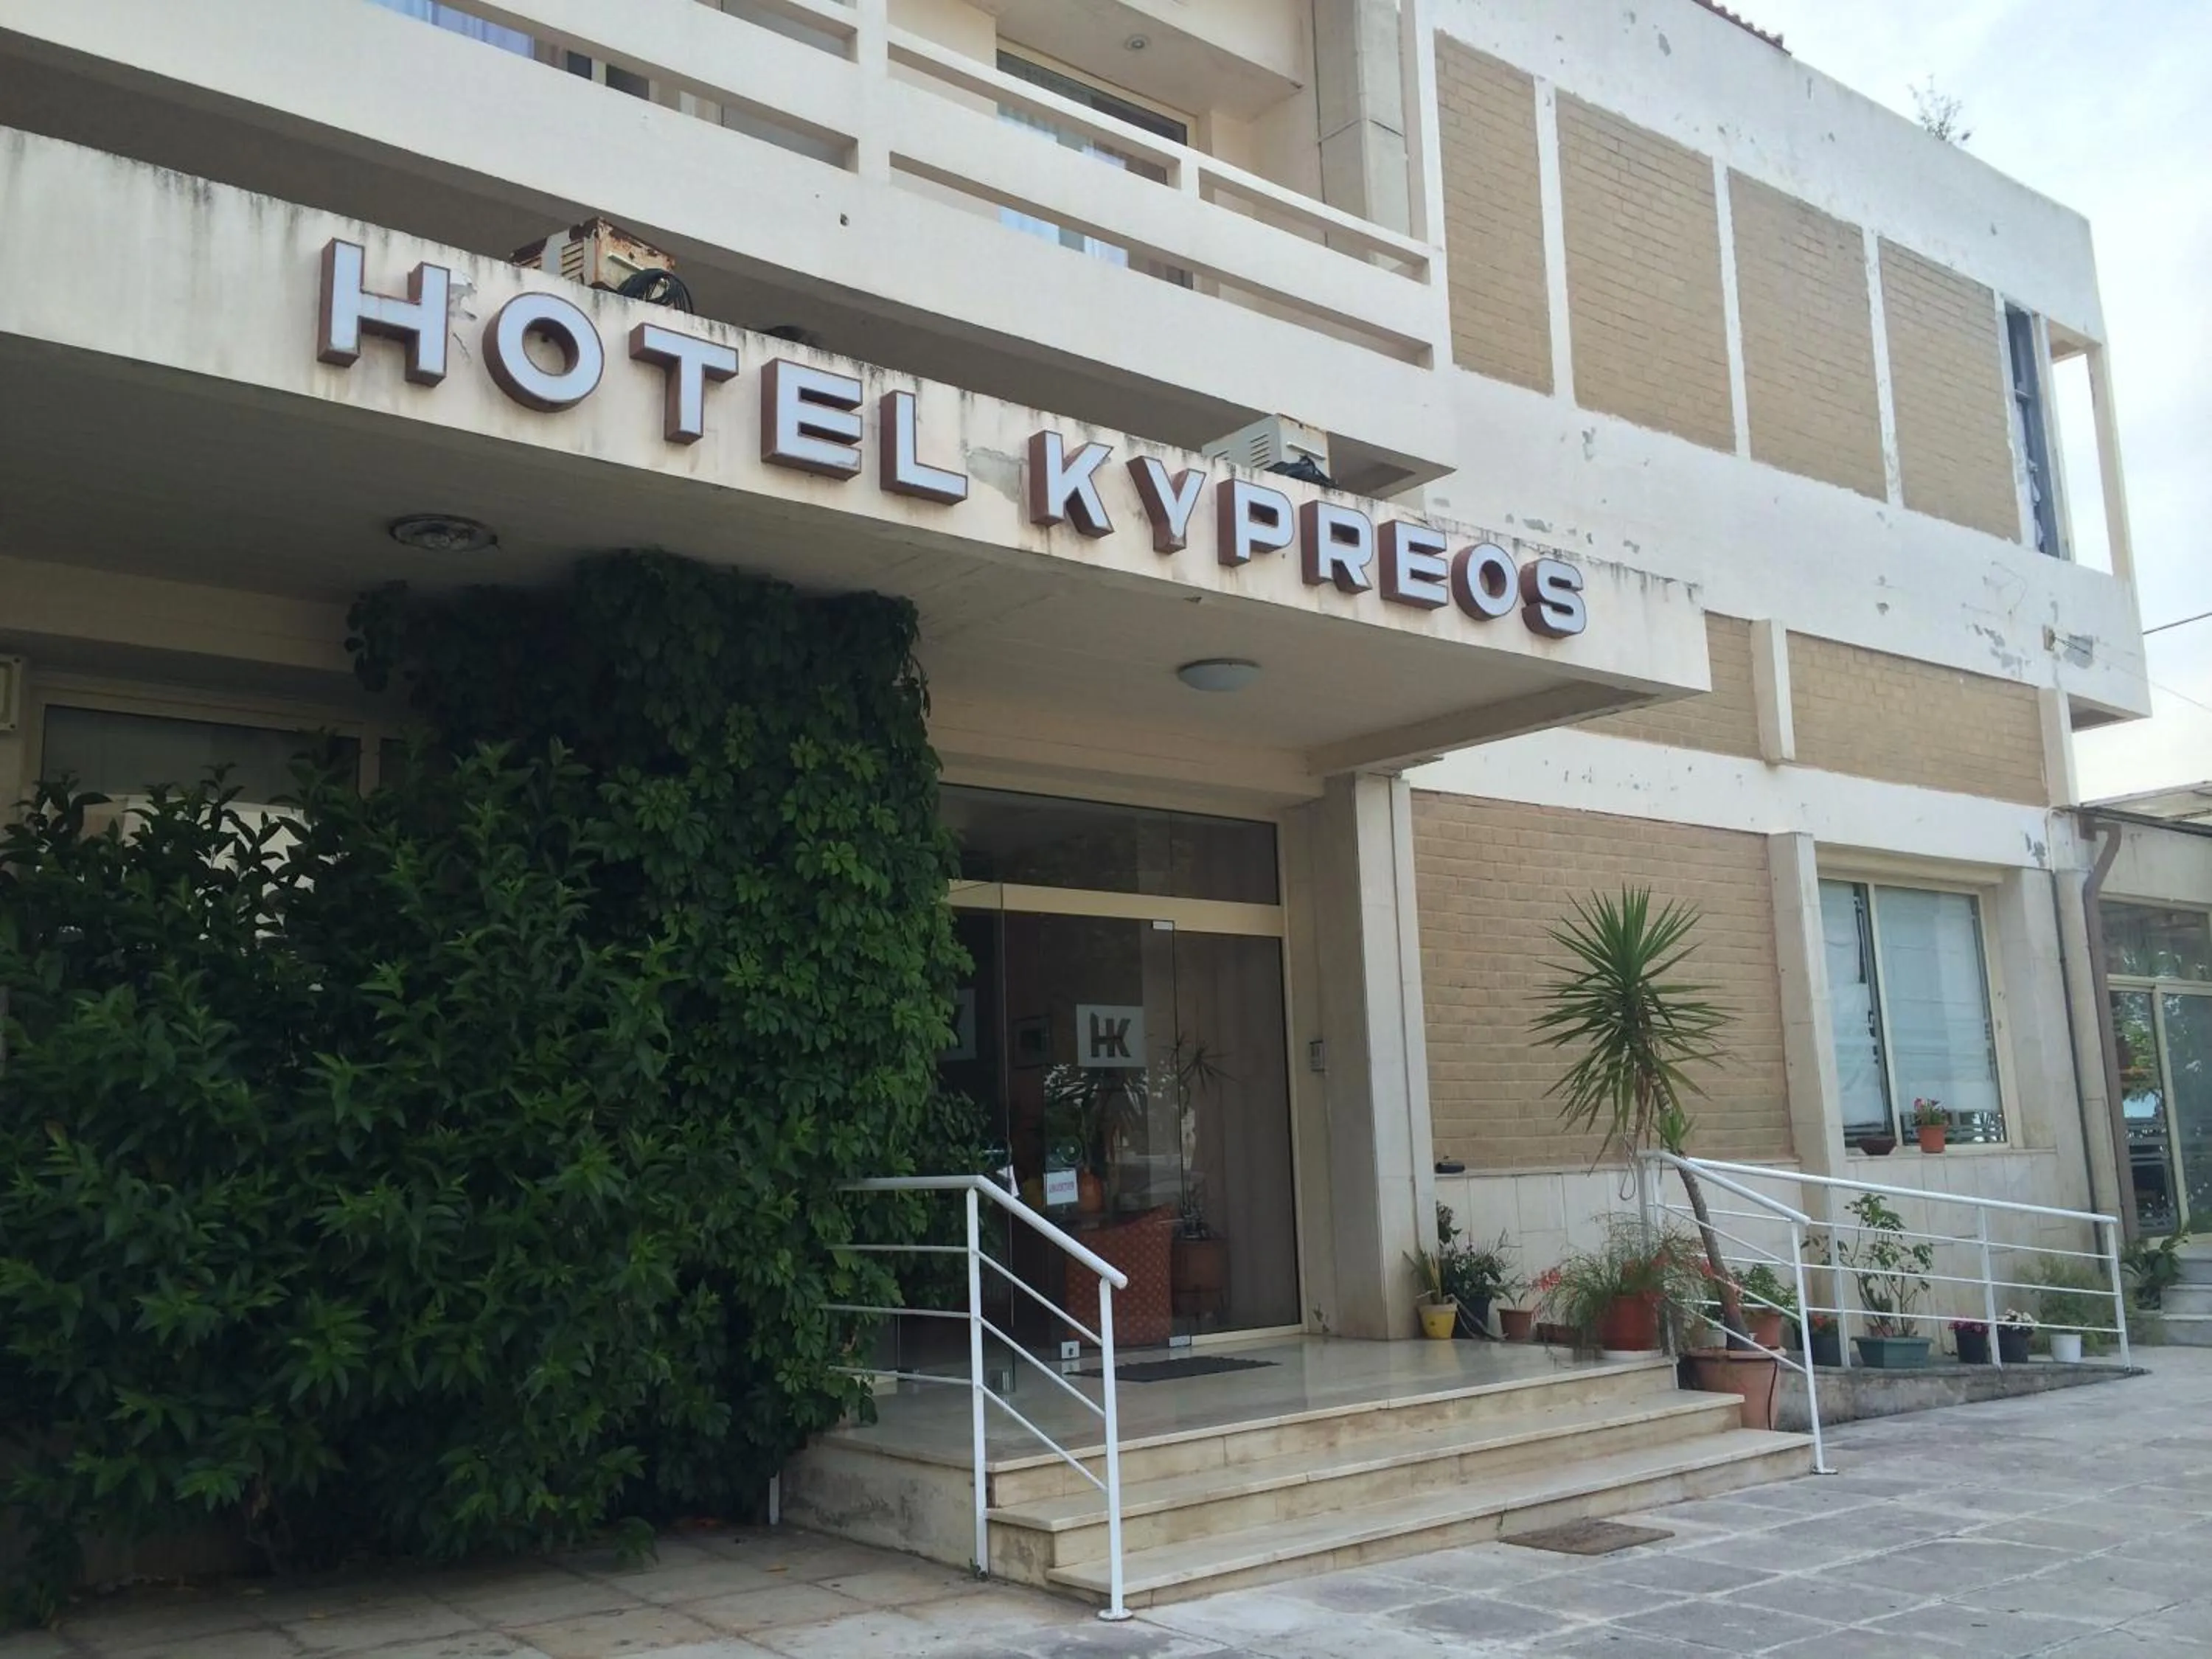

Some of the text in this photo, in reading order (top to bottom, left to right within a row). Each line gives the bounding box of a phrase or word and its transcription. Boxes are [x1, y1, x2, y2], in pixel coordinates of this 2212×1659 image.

[316, 237, 1587, 639] HOTEL KYPREOS
[1090, 1012, 1132, 1058] HK
